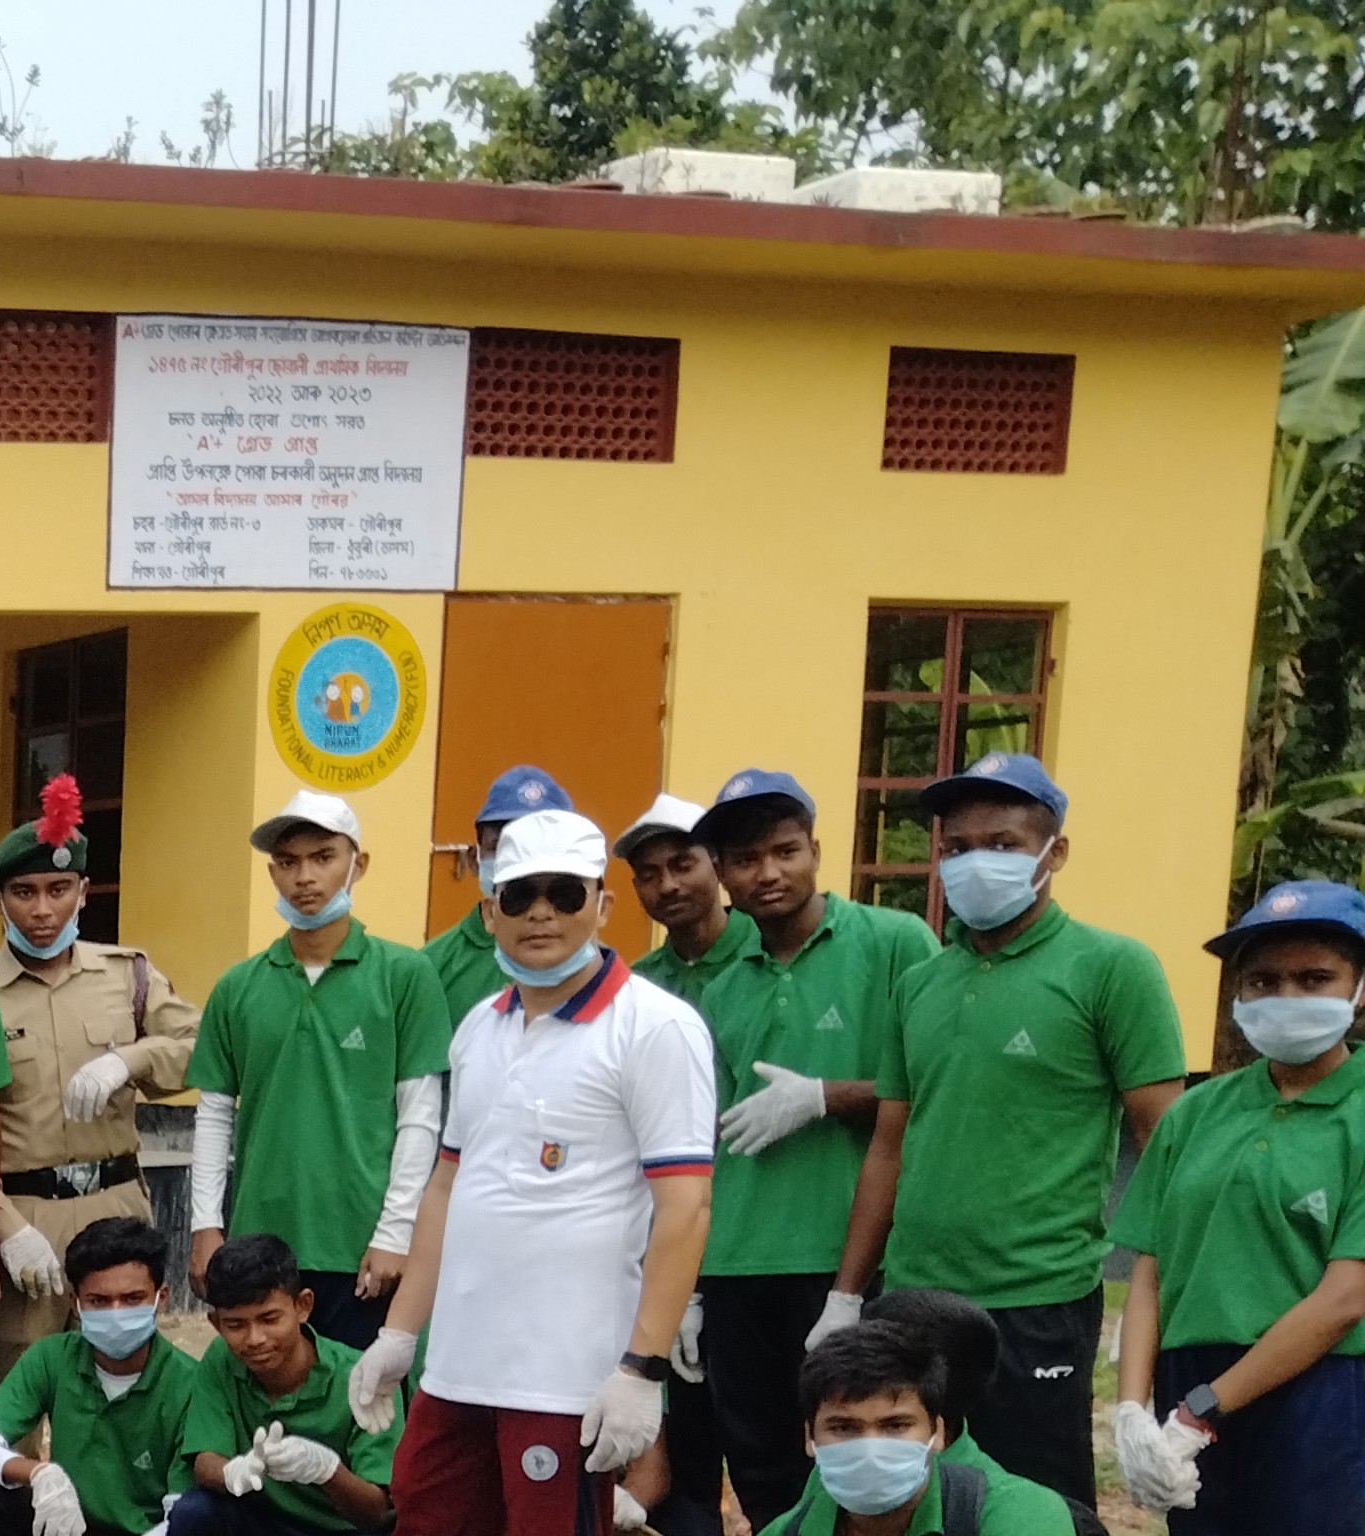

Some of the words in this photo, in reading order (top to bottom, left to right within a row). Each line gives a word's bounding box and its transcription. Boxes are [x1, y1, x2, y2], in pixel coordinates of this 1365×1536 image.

[248, 384, 283, 405] ২০২২
[328, 385, 372, 405] ২০২৩
[276, 668, 315, 773] FOUNDATIONAL
[318, 762, 375, 783] LITERACY
[385, 690, 419, 760] NUMERACY
